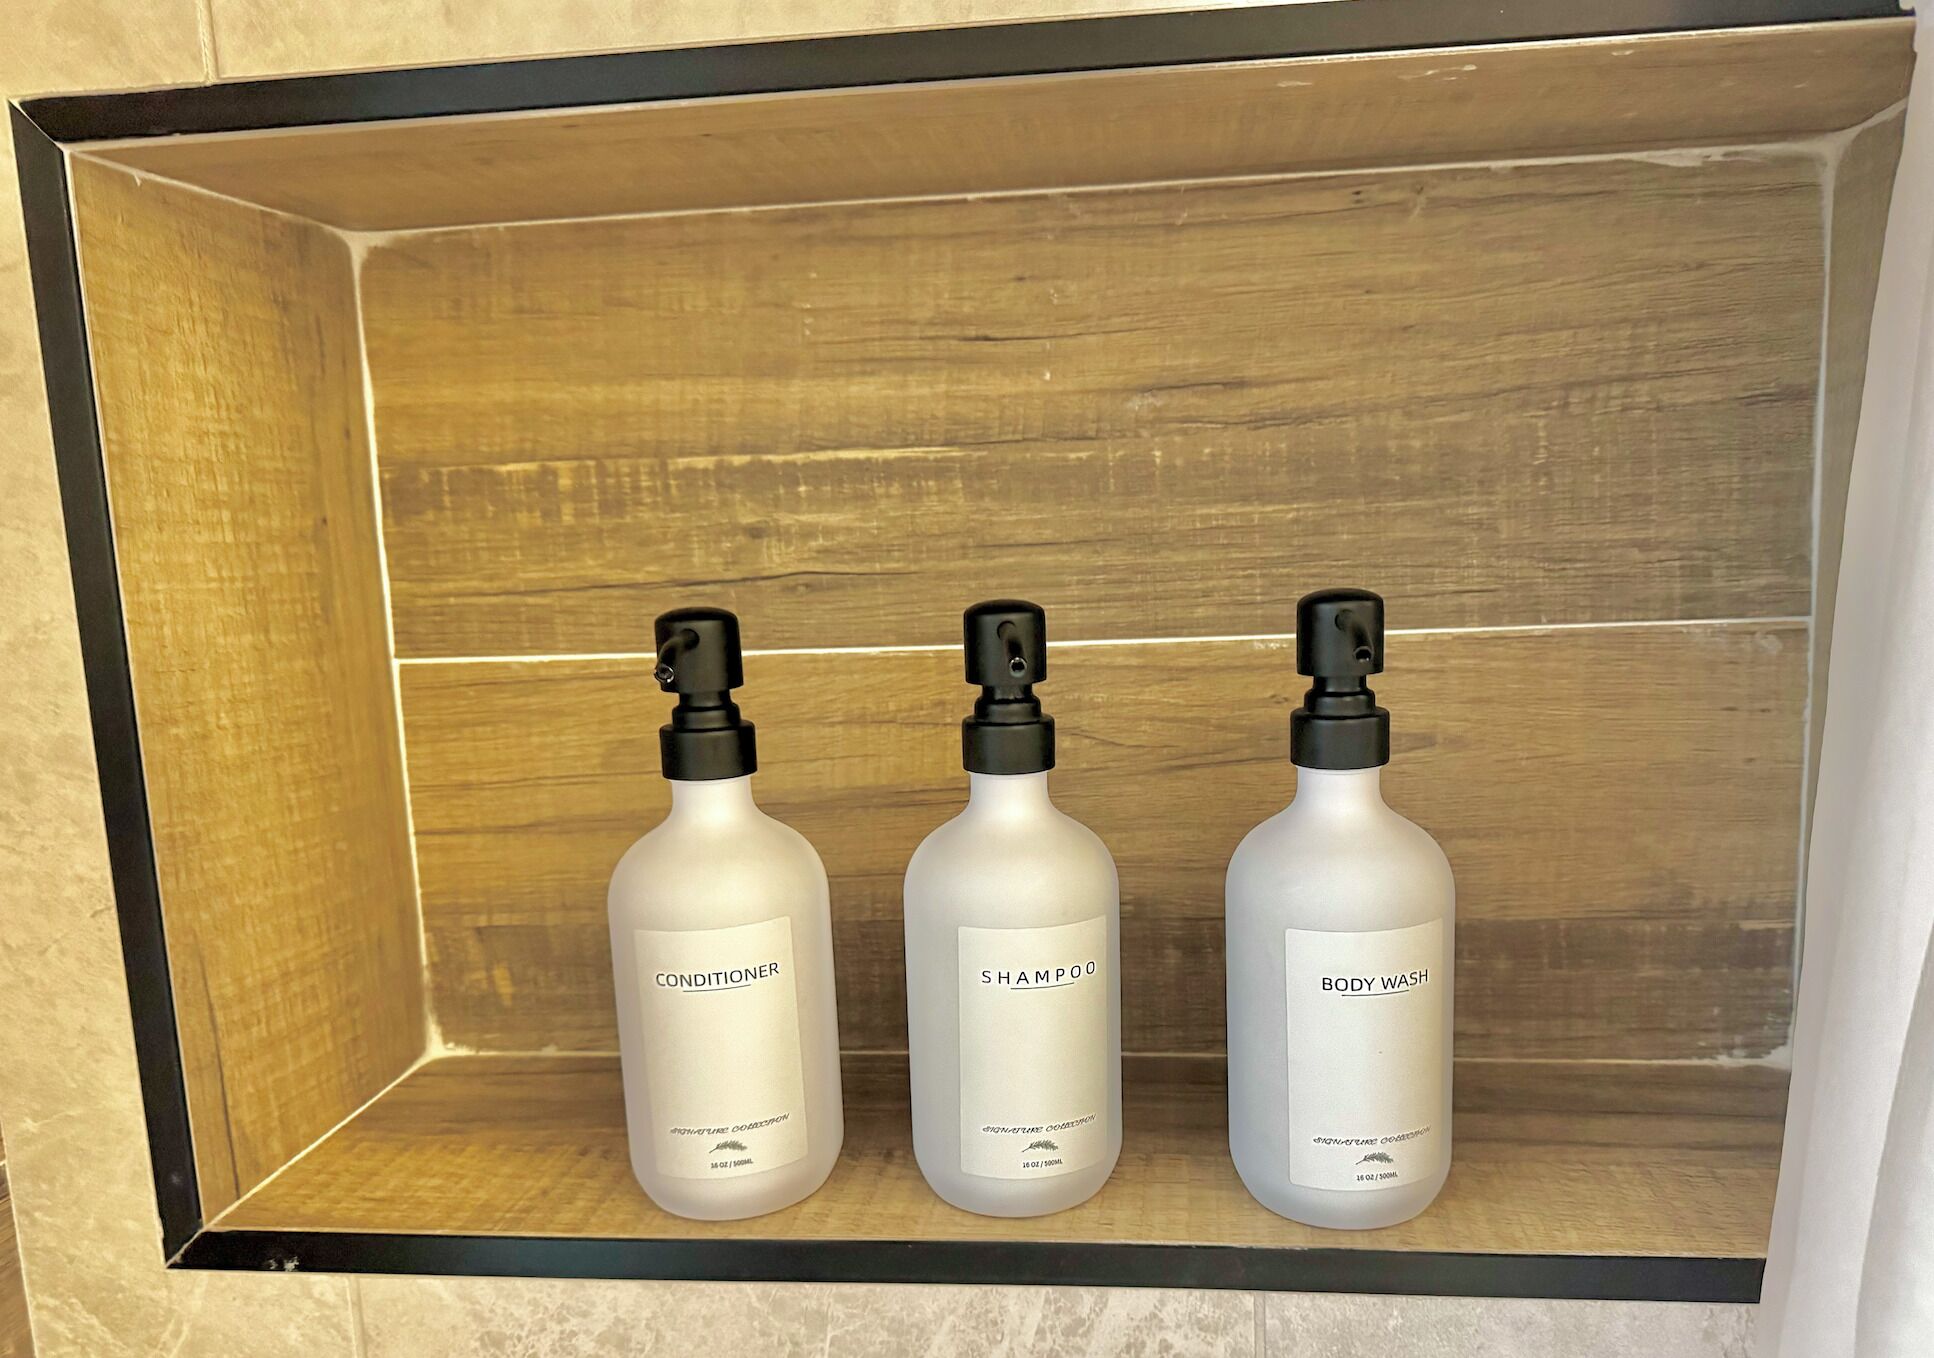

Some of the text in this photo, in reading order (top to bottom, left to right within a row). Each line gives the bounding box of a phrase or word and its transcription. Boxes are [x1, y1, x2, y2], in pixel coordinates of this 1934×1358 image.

[655, 962, 779, 987] CONDITIONER
[981, 961, 1096, 985] SHAMPOO
[1321, 969, 1429, 992] BODY WASH
[670, 1113, 790, 1136] SIGNATURE COLLECTION
[982, 1113, 1097, 1134] SIGNATURE COLLECTION
[1312, 1136, 1378, 1146] SIGNATURE
[719, 1161, 728, 1169] OZ
[1022, 1161, 1030, 1169] 16
[1356, 1174, 1364, 1182] 16
